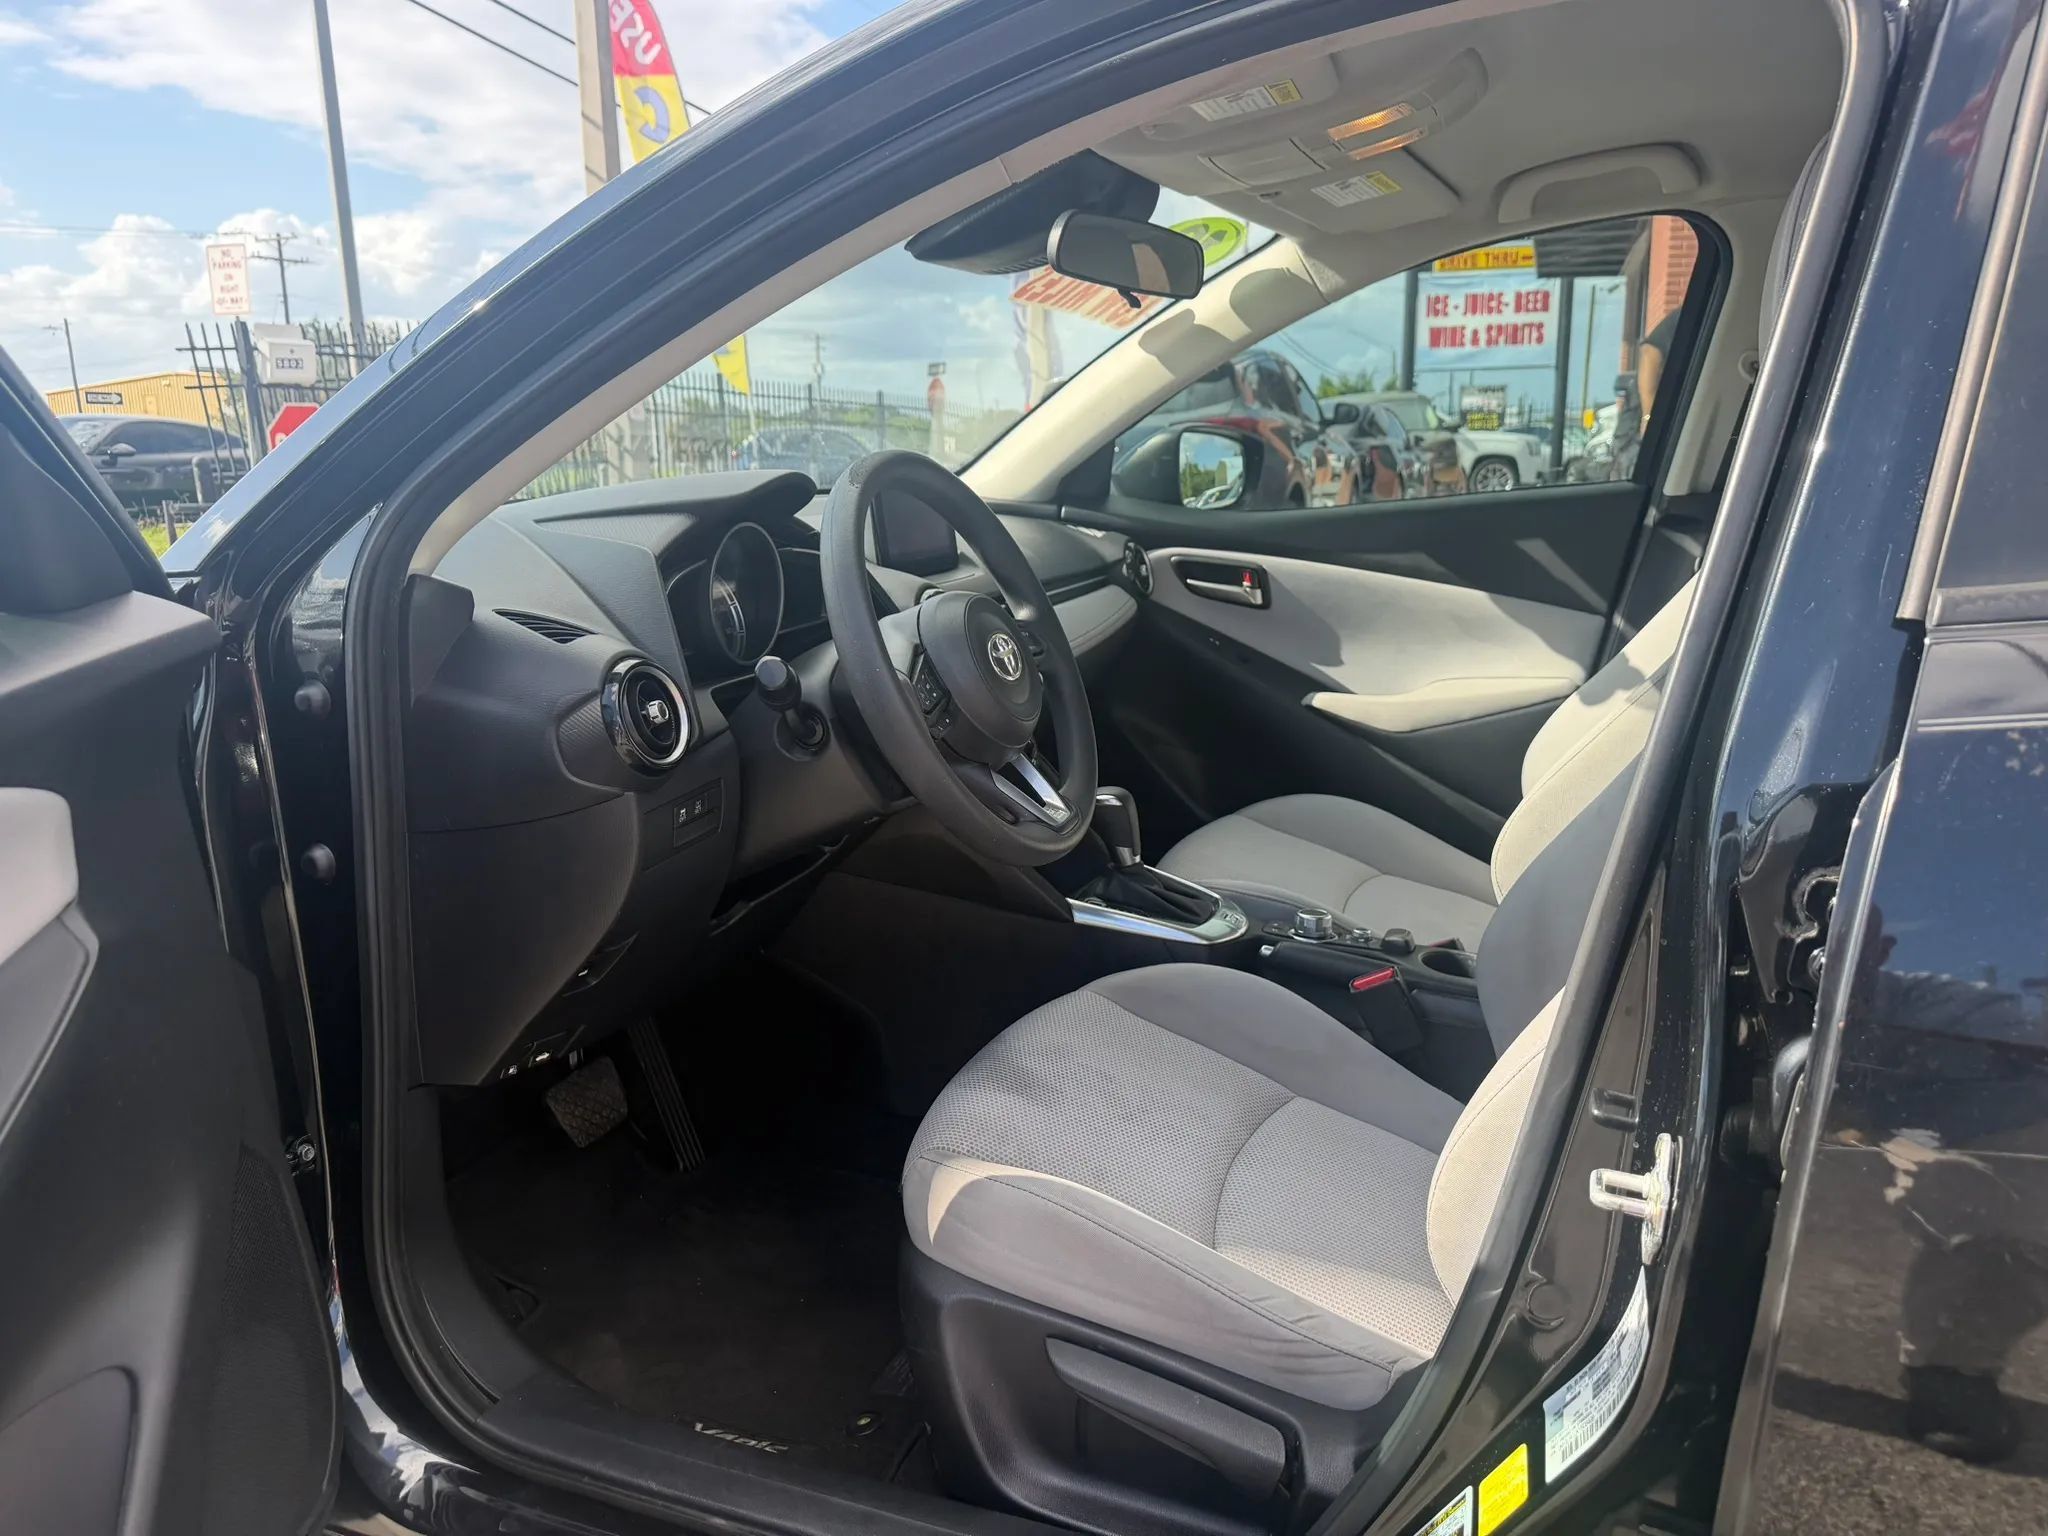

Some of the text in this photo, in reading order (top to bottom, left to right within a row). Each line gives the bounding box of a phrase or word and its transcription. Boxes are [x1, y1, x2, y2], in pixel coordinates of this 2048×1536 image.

[212, 261, 242, 271] PARKING
[1426, 294, 1449, 317] ICE
[1514, 290, 1550, 313] BEER
[1429, 321, 1545, 348] WINE & SPIRITS
